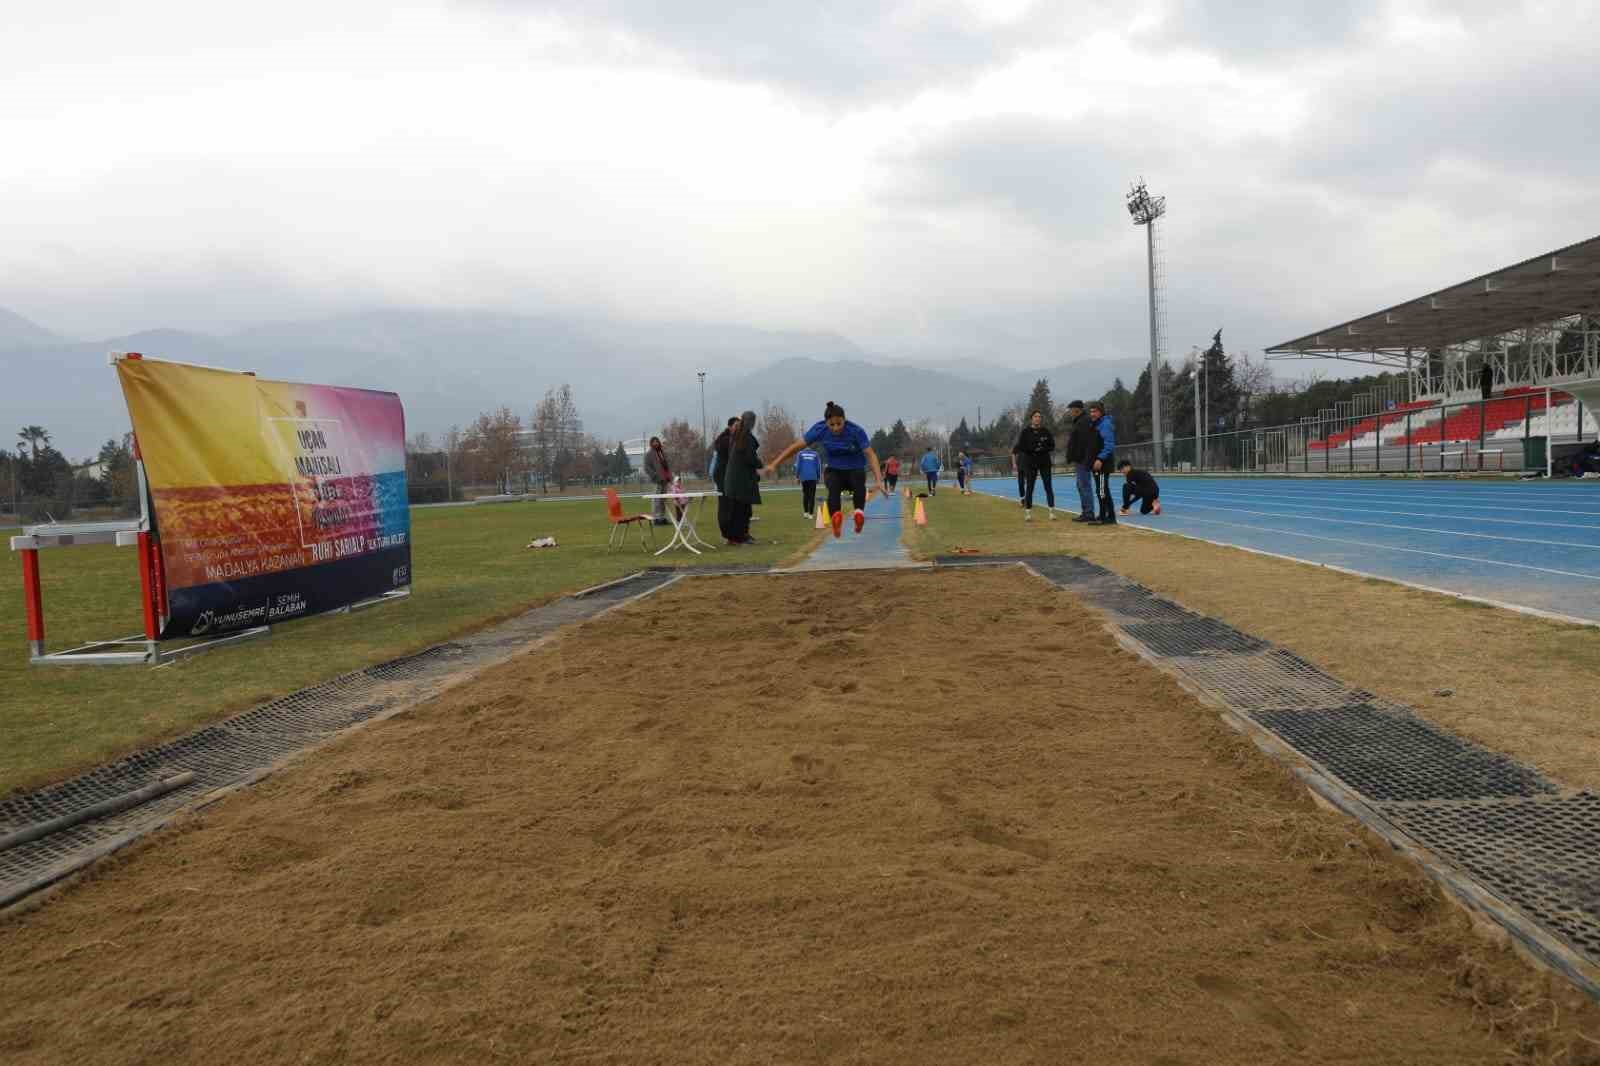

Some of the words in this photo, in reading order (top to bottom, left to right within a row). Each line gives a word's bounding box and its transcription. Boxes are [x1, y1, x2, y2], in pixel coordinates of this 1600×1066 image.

[297, 430, 327, 452] UÇAN
[205, 560, 259, 579] MADALYA
[213, 606, 265, 625] YUNUSEMRE
